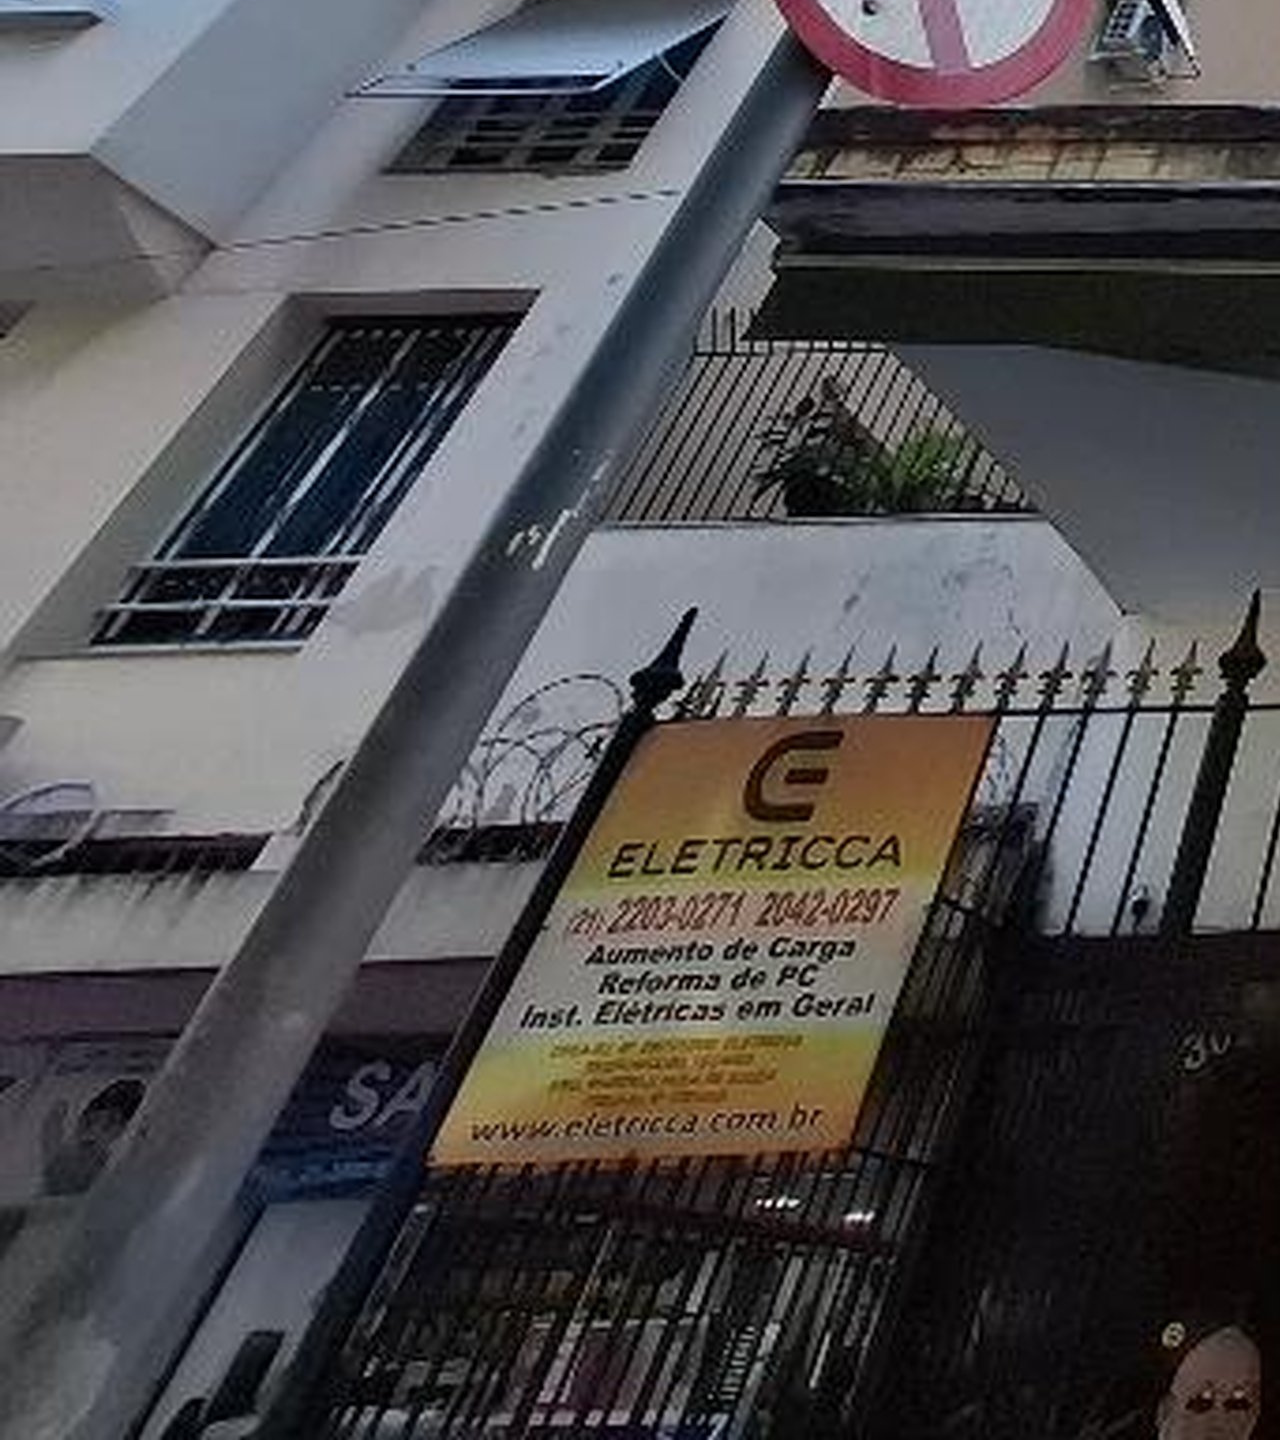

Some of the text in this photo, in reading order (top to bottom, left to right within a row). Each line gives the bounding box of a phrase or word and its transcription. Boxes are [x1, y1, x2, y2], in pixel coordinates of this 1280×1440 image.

[606, 834, 901, 878] ELETRICCA
[606, 890, 747, 935] 2203-0271
[754, 887, 899, 928] 2042-0297
[584, 936, 857, 965] Aumento de Carga
[598, 963, 820, 995] Reforma de PC
[519, 991, 876, 1029] Inst. Elétricas em Geral
[470, 1100, 824, 1143] www.eletricca.com.br
